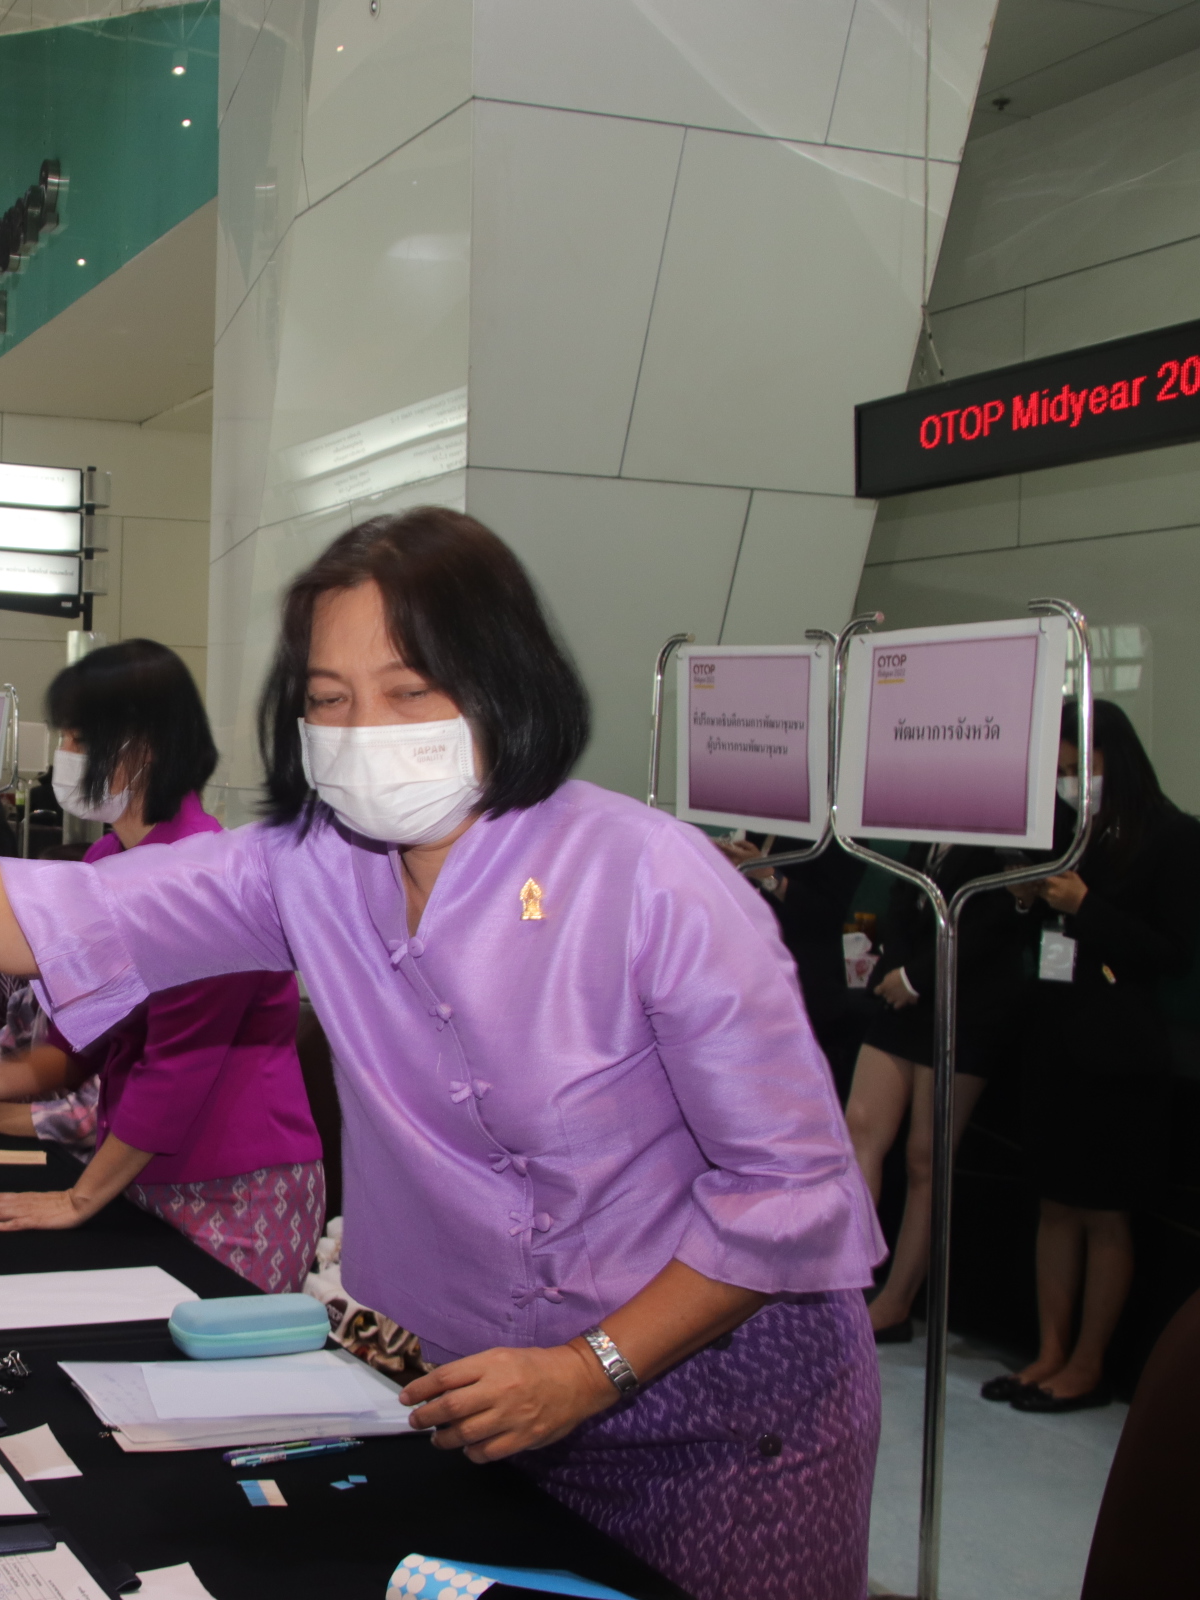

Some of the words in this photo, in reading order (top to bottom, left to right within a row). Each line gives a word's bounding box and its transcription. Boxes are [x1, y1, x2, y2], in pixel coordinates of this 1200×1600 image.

[919, 400, 1005, 450] OTOP
[1012, 376, 1147, 428] Midyear
[877, 653, 907, 668] OTOP
[693, 664, 715, 674] OTOP
[893, 716, 1000, 741] พัฒนาการจังหวัด
[413, 744, 446, 757] JAPAN
[416, 753, 443, 763] QUALITY
